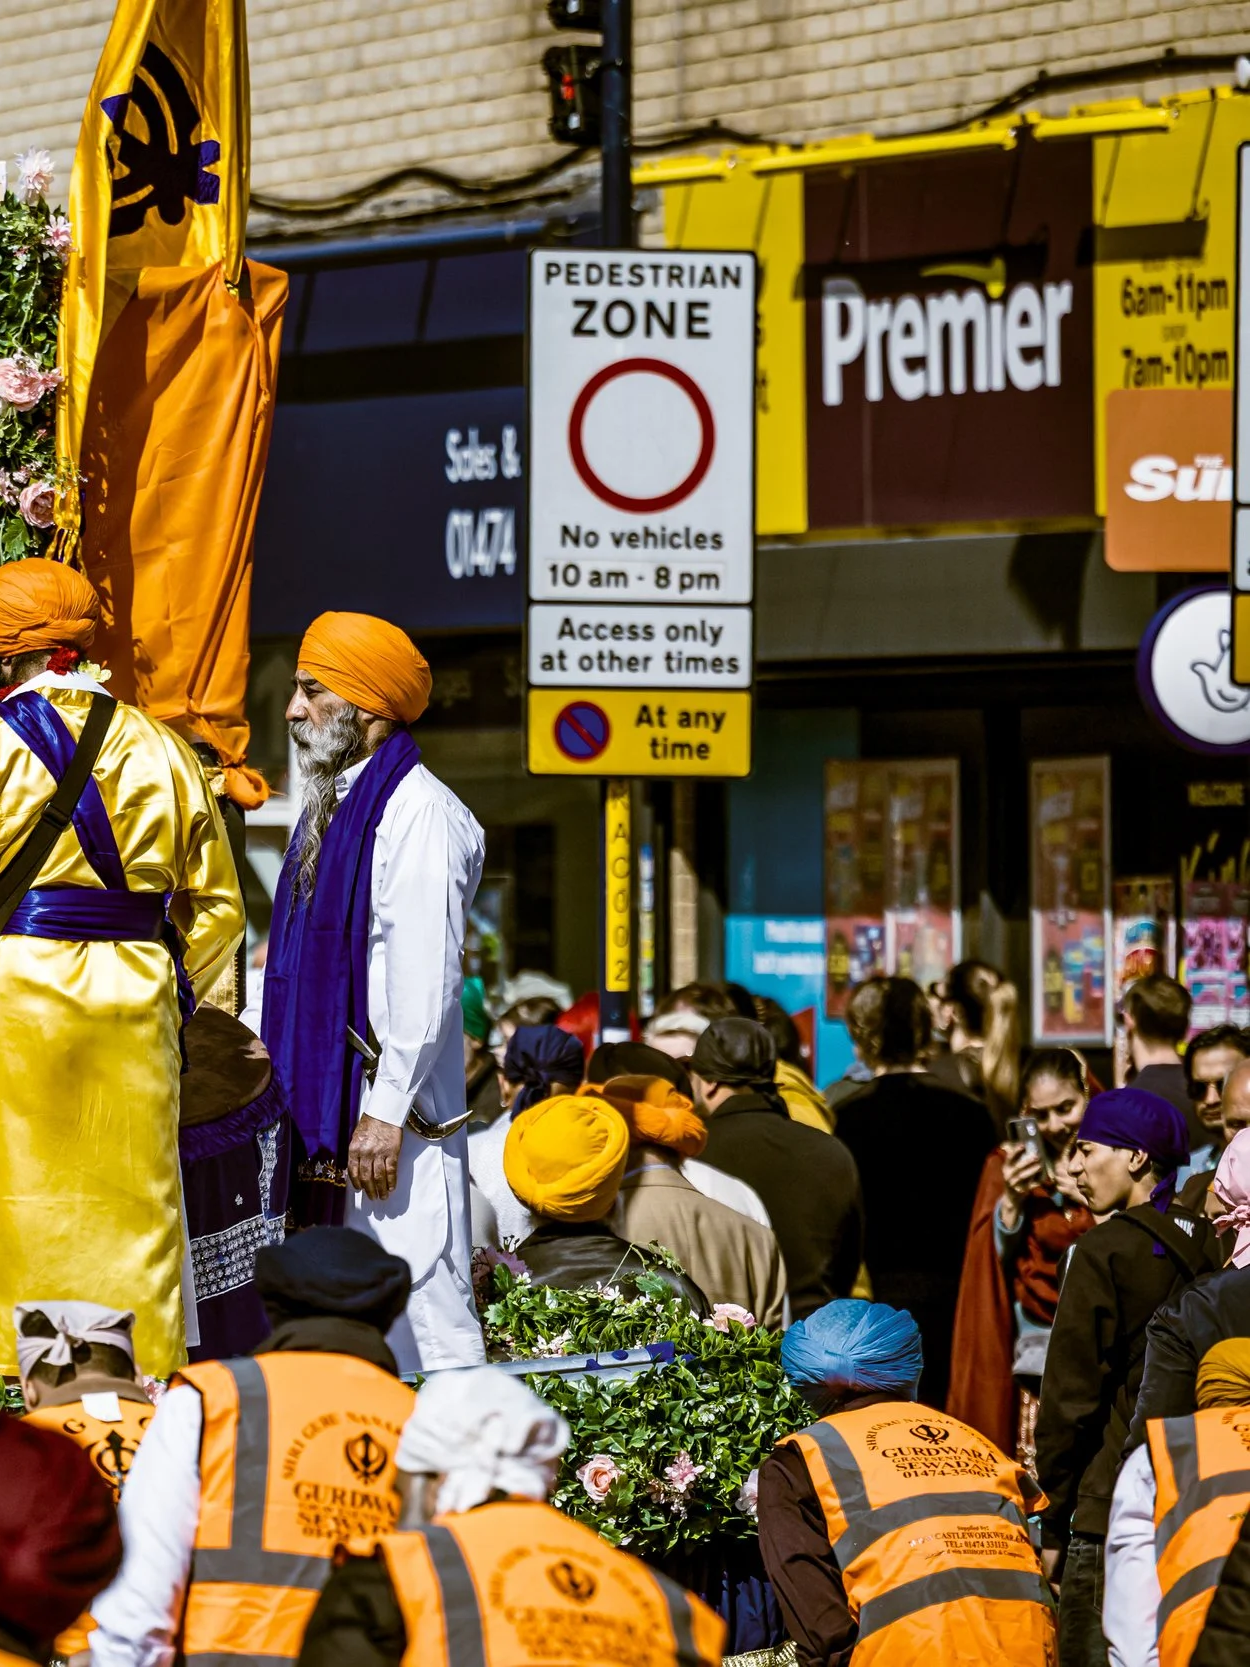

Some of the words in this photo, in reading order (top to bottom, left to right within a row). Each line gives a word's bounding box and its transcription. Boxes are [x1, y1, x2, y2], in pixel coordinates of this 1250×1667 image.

[545, 262, 742, 289] PEDESTRIAN
[571, 298, 712, 339] ZONE
[822, 278, 1073, 406] Premier
[501, 423, 523, 480] &
[1193, 455, 1225, 469] THE
[560, 525, 600, 549] No
[610, 527, 724, 550] vehicles
[548, 563, 581, 587] 10
[588, 570, 629, 588] am
[654, 566, 671, 589] 8
[679, 572, 720, 594] pm
[557, 617, 655, 641] Access
[665, 620, 724, 647] only
[540, 650, 568, 672] at
[578, 650, 653, 673] other
[665, 651, 740, 674] times
[635, 704, 667, 728] At
[678, 710, 726, 734] any
[649, 737, 710, 760] time
[871, 1420, 901, 1430] GURU
[866, 1430, 879, 1451] SHRI
[881, 1446, 999, 1464] GURDWARA
[895, 1461, 998, 1472] SEWADAR
